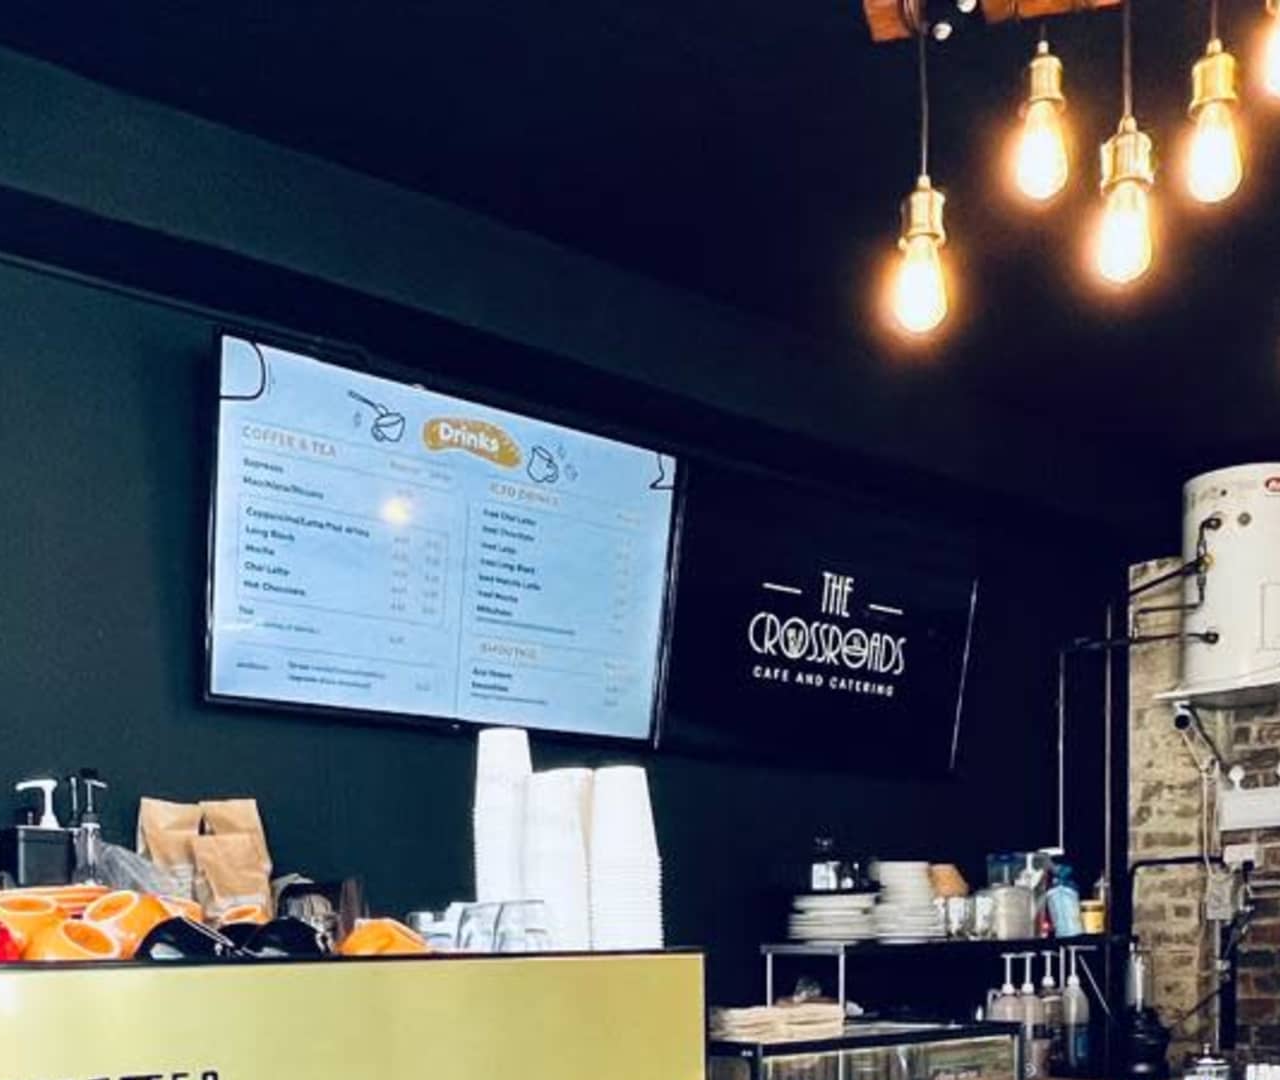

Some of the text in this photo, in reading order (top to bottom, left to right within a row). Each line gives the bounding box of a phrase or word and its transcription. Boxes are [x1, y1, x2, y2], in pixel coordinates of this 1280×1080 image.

[242, 426, 296, 448] COFFEE
[313, 441, 336, 457] TEA
[439, 421, 499, 452] Drinks
[821, 571, 854, 618] THE
[748, 611, 907, 675] CROSSROADS
[752, 665, 895, 697] CAFE AND CATERING
